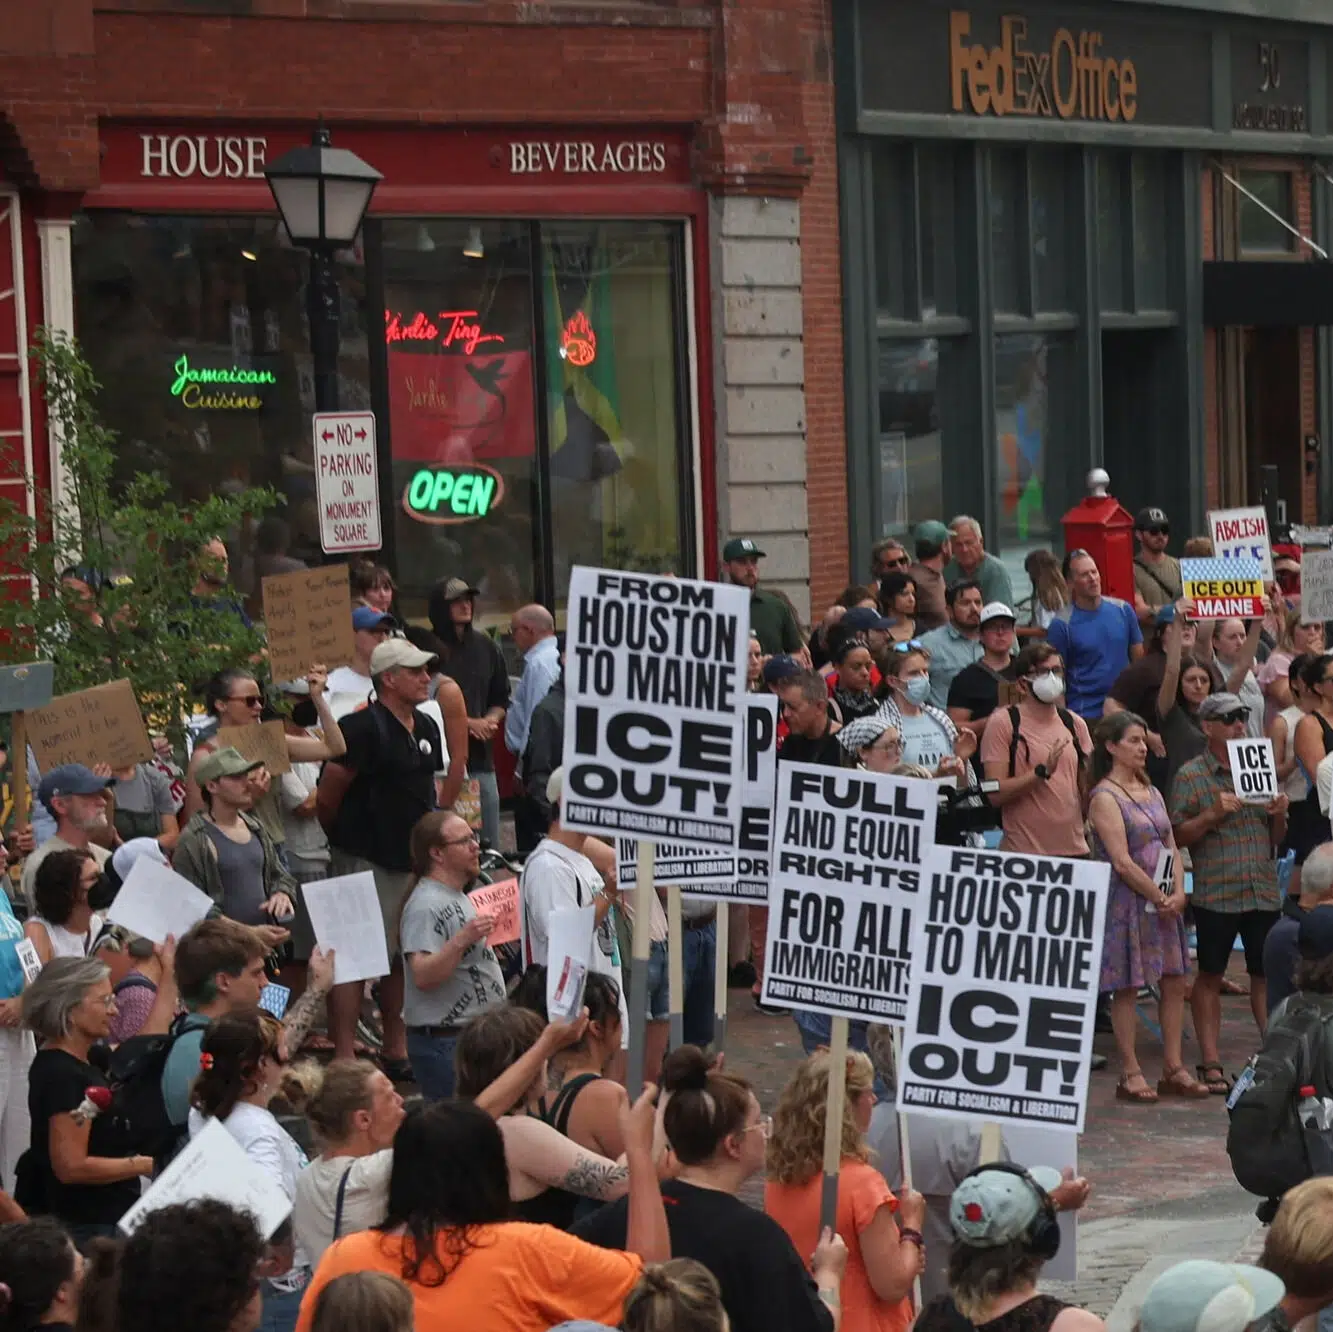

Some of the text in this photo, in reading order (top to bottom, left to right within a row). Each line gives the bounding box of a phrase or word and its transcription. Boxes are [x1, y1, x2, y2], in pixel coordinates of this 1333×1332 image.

[950, 10, 1137, 121] FedEx Office
[140, 135, 266, 178] HOUSE
[510, 142, 666, 173] BEVERAGES
[171, 354, 275, 395] Jamaican
[182, 382, 262, 409] Cuisine
[337, 423, 353, 446] NO
[320, 453, 372, 476] PARKING
[342, 480, 354, 497] ON
[409, 469, 495, 515] OPEN
[326, 502, 372, 520] MONUMENT
[334, 524, 368, 542] SQUARE
[1215, 517, 1266, 542] ABOLISH
[597, 575, 714, 609] FROM
[1191, 580, 1257, 595] ICE OUT
[1197, 599, 1255, 616] MAINE
[578, 597, 736, 663] HOUSTON
[576, 647, 735, 713] TO MAINE
[575, 706, 733, 775] ICE
[1237, 745, 1269, 769] ICE
[569, 764, 732, 817] OUT!
[790, 771, 924, 820] FULL
[1240, 772, 1272, 792] OUT
[568, 805, 732, 840] PARTY FOR SOCIALISM LIBERATION
[783, 807, 835, 850] AND
[844, 816, 921, 863] EQUAL
[780, 852, 918, 893] RIGHTS
[950, 852, 1074, 885] FROM
[779, 889, 912, 960] FOR ALL
[929, 874, 1096, 940] HOUSTON
[924, 925, 1093, 991] TO MAINE
[768, 981, 858, 1008] PARTY FOR SOCIALISM
[916, 985, 1086, 1053] ICE
[908, 1042, 1080, 1097] OUT!
[904, 1085, 1077, 1120] PARTY FOR SOCIALISM LIBERATION
